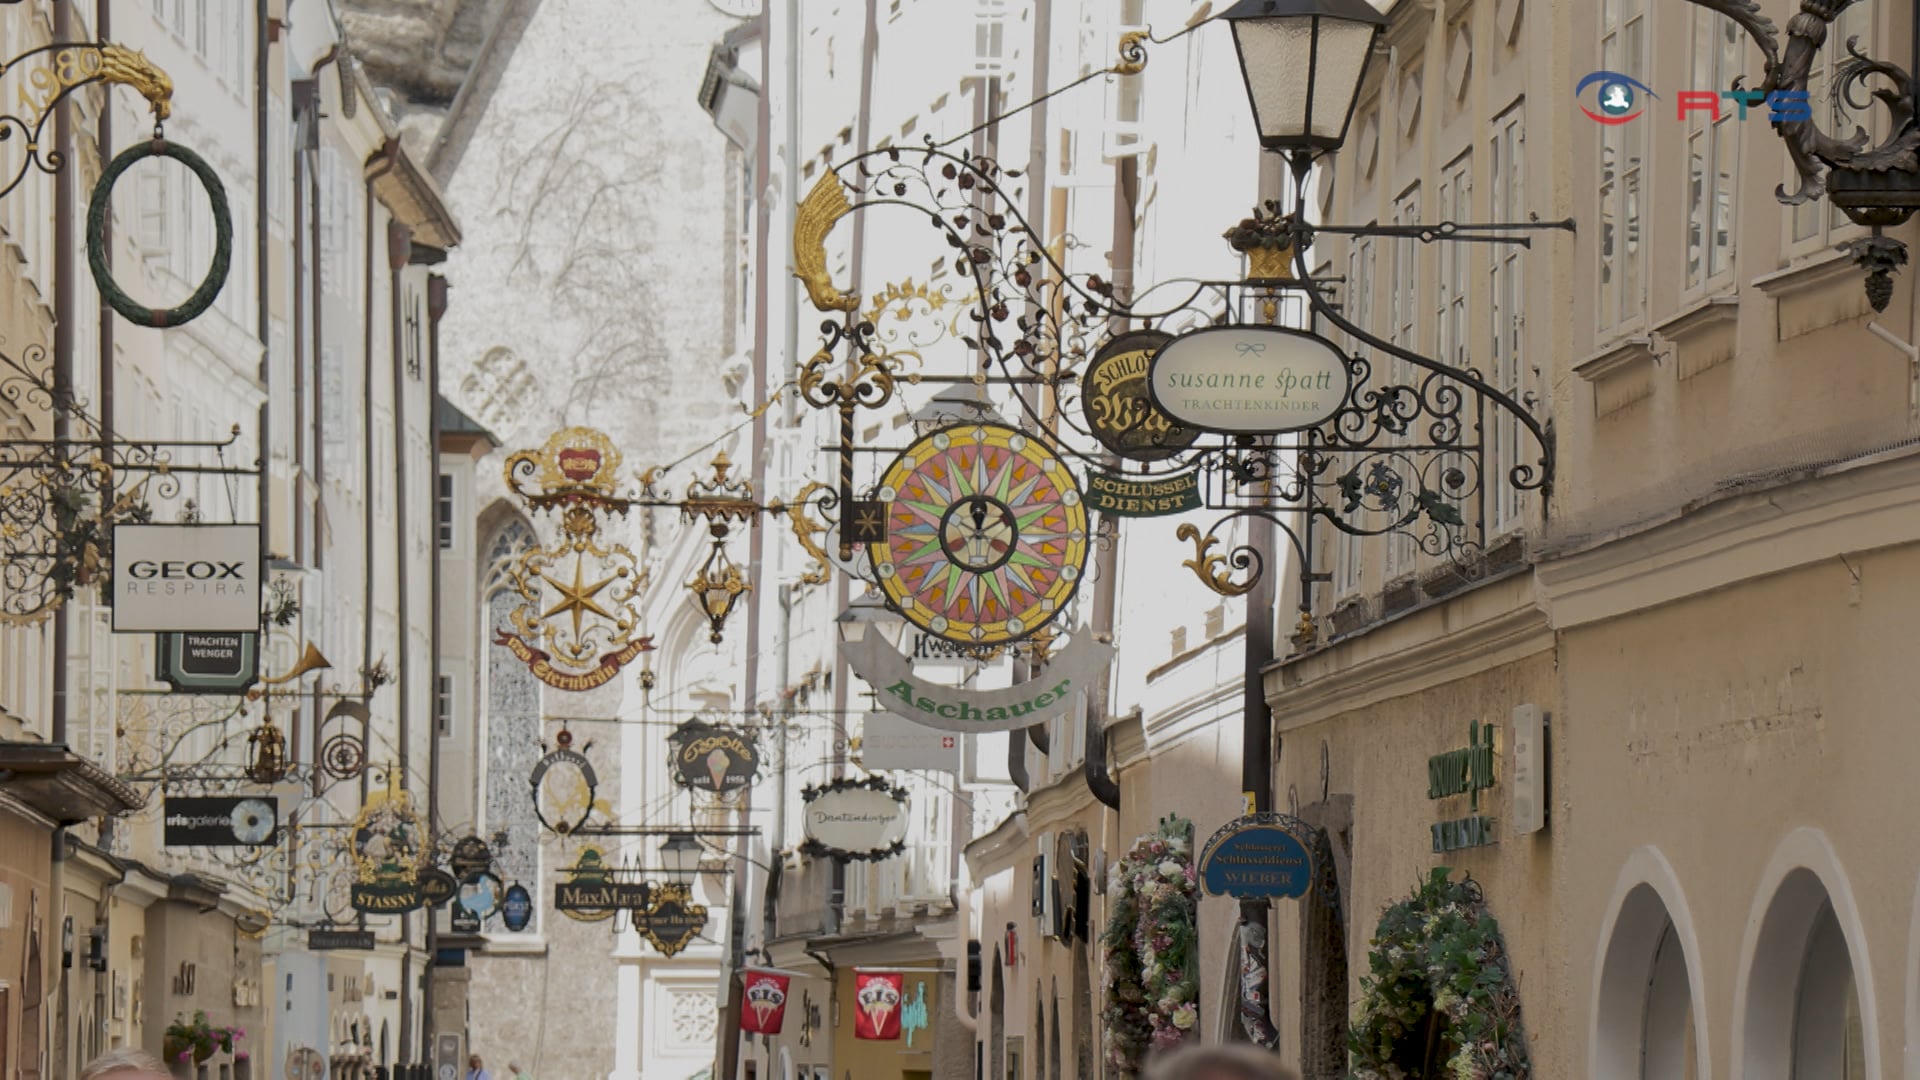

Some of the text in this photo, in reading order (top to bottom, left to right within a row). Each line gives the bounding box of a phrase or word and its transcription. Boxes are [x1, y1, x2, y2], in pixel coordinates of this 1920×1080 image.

[18, 49, 102, 127] 1980
[1168, 368, 1332, 397] susanne spatt
[1182, 399, 1320, 411] TRACHTENKINDER
[1101, 494, 1184, 512] DIENST
[128, 561, 245, 580] GEOX
[127, 582, 245, 594] RESPIRA
[188, 637, 238, 647] TRACHTEN
[191, 649, 233, 658] WENGER
[886, 679, 1071, 721] Aschauer
[357, 892, 416, 908] STASSNY
[562, 887, 642, 906] MaxMara
[750, 989, 783, 1004] EIS
[862, 990, 898, 1004] EIS
